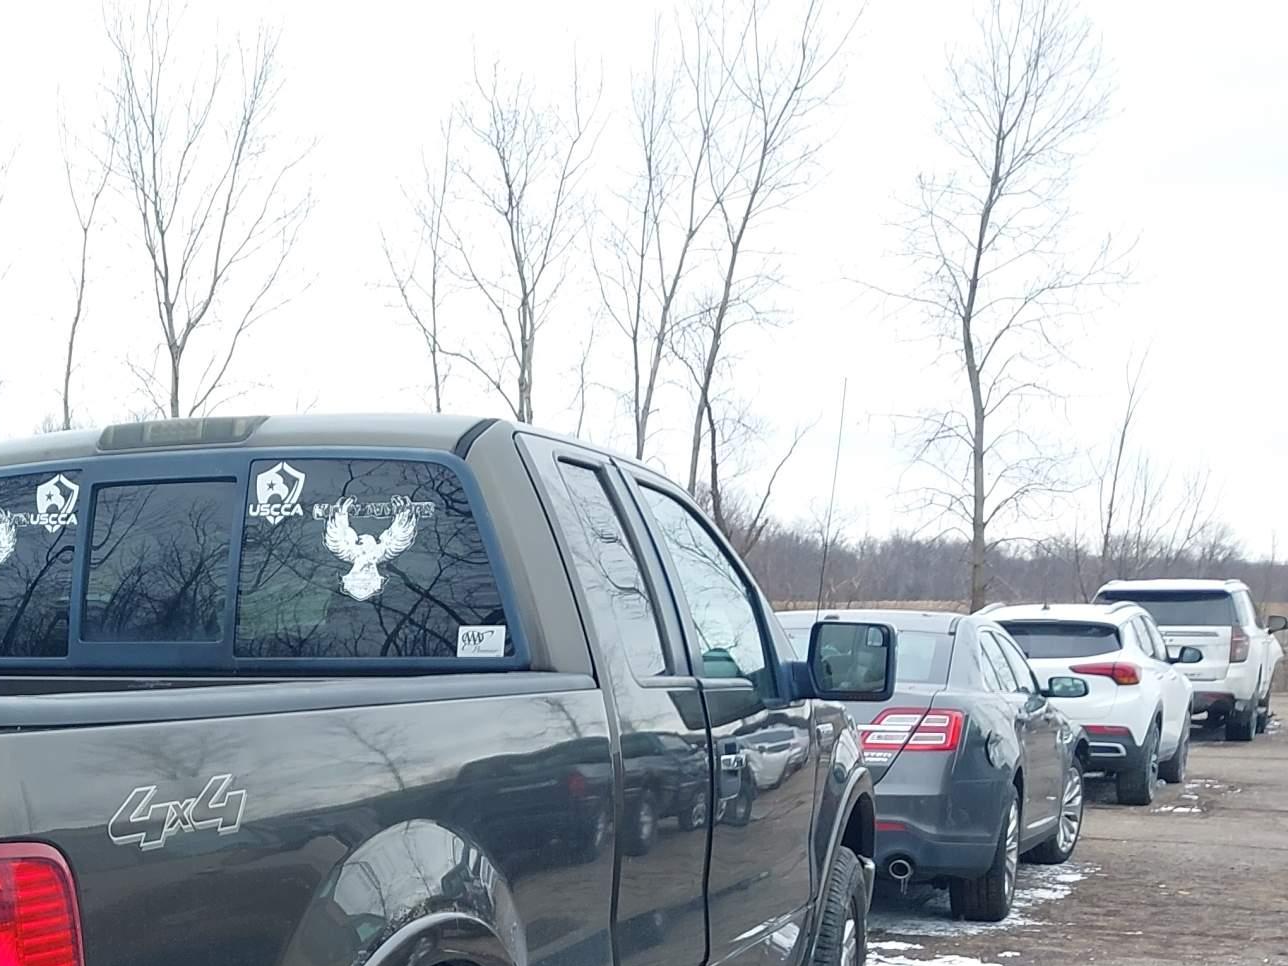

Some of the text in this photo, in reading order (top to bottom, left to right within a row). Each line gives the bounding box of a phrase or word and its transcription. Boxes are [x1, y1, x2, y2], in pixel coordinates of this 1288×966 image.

[249, 503, 304, 517] USCCA
[30, 513, 78, 525] USCCA
[108, 773, 247, 852] 4x4
